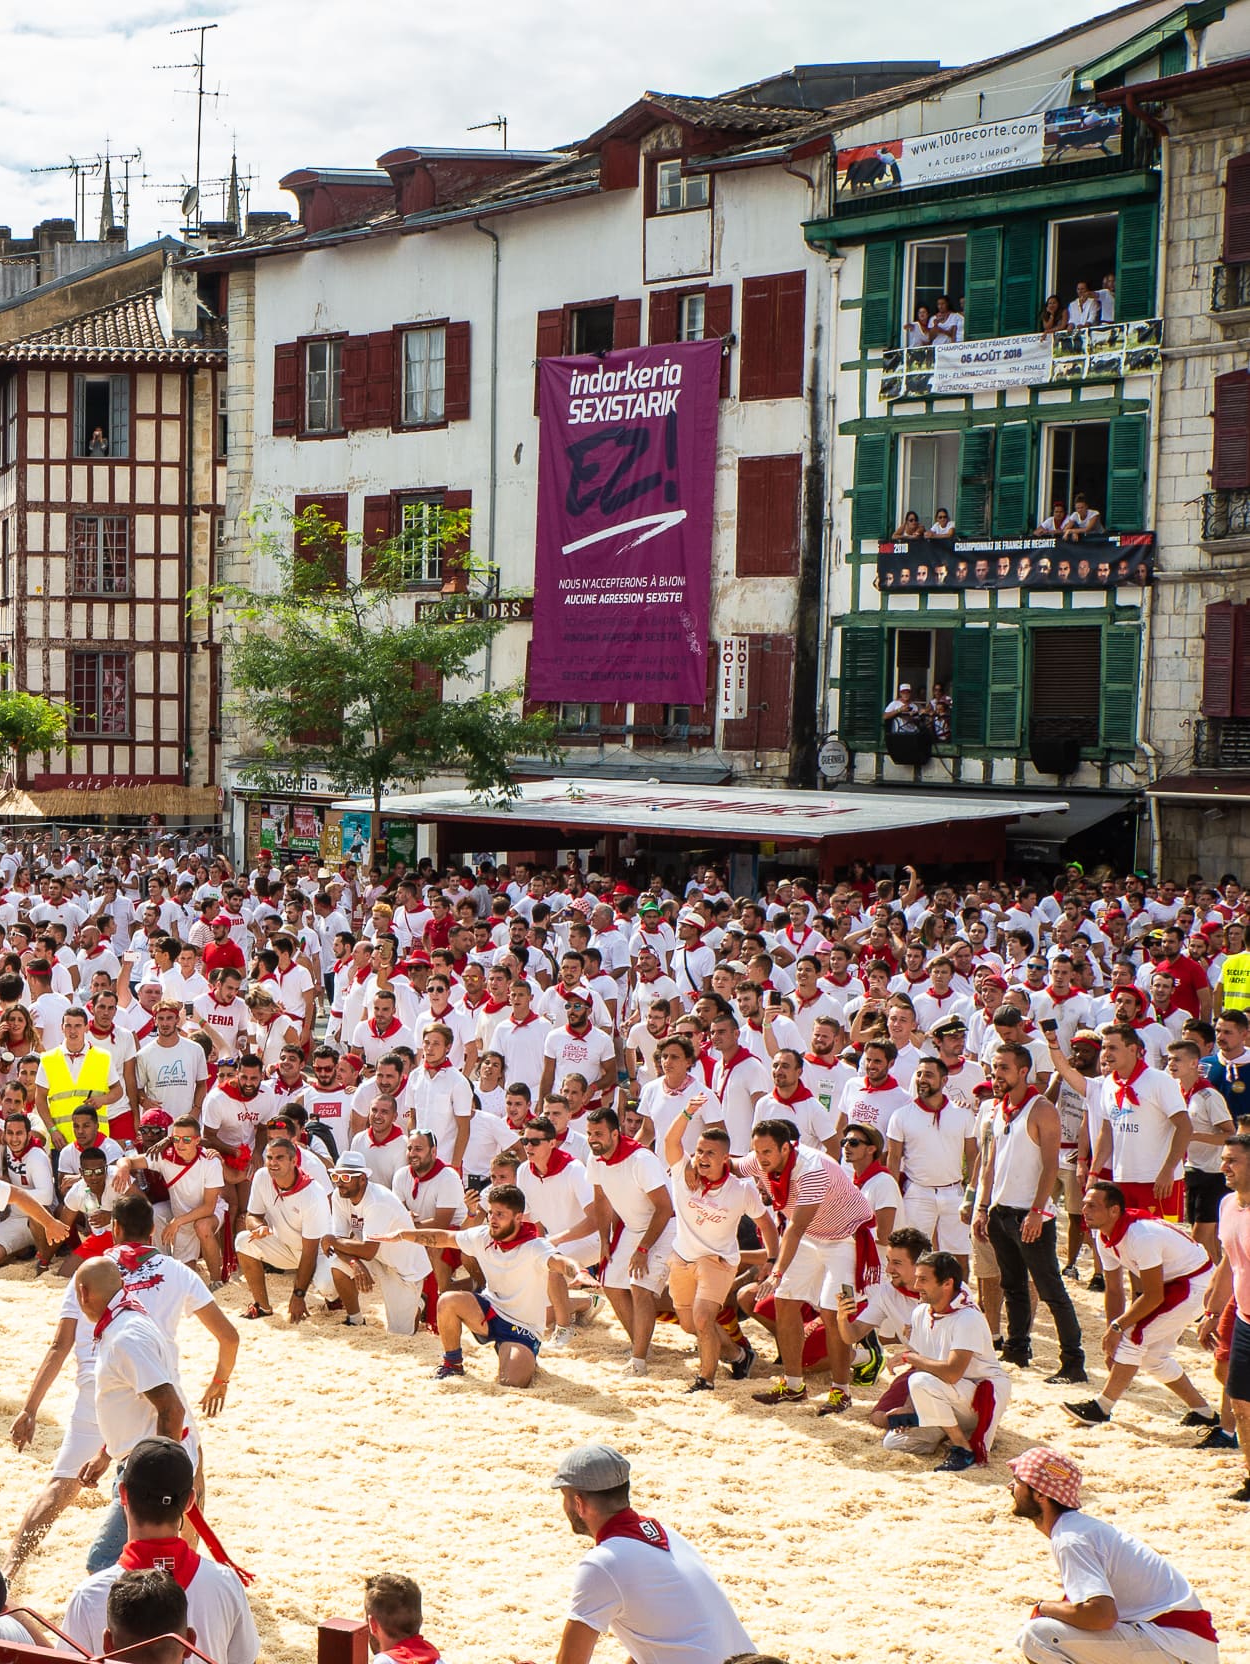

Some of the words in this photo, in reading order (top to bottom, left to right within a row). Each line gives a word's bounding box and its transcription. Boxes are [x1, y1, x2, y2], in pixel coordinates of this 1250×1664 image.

[911, 124, 1038, 156] www.100recorte.com
[960, 354, 972, 363] 05
[974, 349, 1002, 362] AOÛT
[1004, 348, 1022, 359] 2018
[569, 358, 682, 395] indarkeria
[568, 389, 681, 424] SEXISTARIK
[565, 411, 678, 516] EZ!
[558, 578, 581, 589] NOUS
[582, 577, 647, 589] N'ACCEPTERONS
[650, 573, 657, 586] À
[564, 594, 597, 605] AUCUNE
[598, 593, 643, 604] AGRESSION
[645, 592, 683, 603] SEXISTE!
[723, 640, 733, 702] HOTEL
[207, 1014, 234, 1027] FERIA
